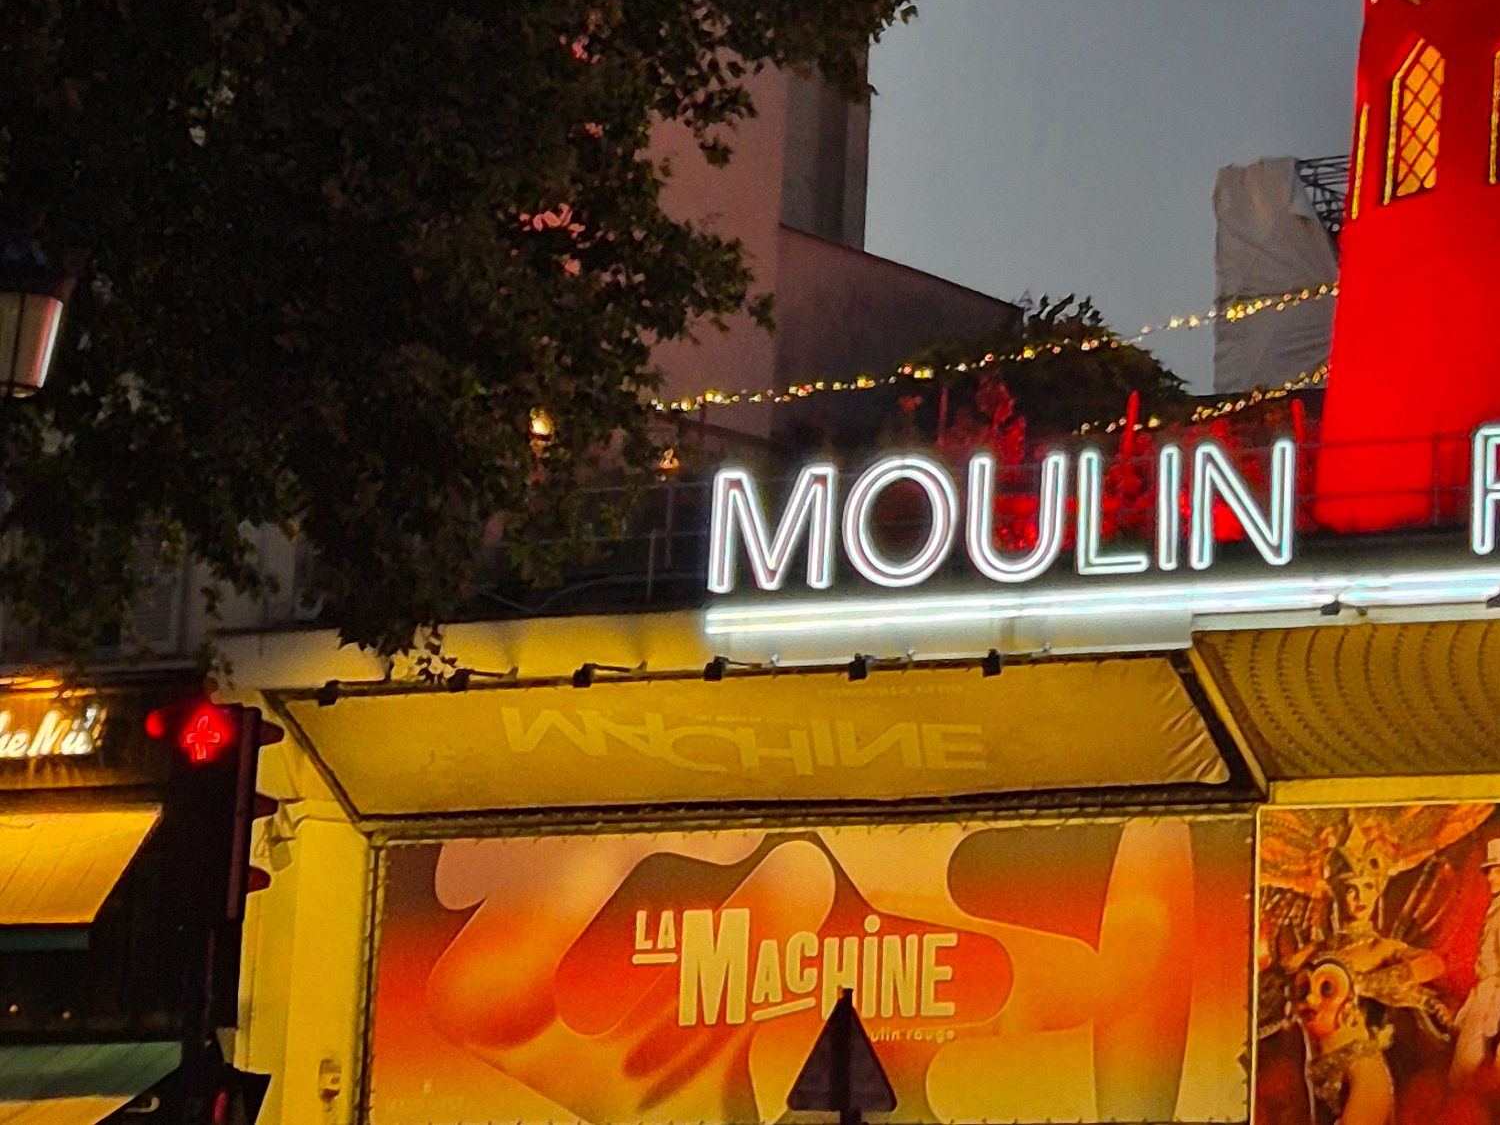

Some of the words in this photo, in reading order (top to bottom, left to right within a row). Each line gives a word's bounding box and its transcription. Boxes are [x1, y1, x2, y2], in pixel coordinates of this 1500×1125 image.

[706, 439, 1295, 595] MOULIN
[634, 910, 677, 951] LA
[678, 907, 958, 1027] MACHiNE
[869, 1025, 901, 1043] ulin
[905, 1028, 956, 1044] rouge
